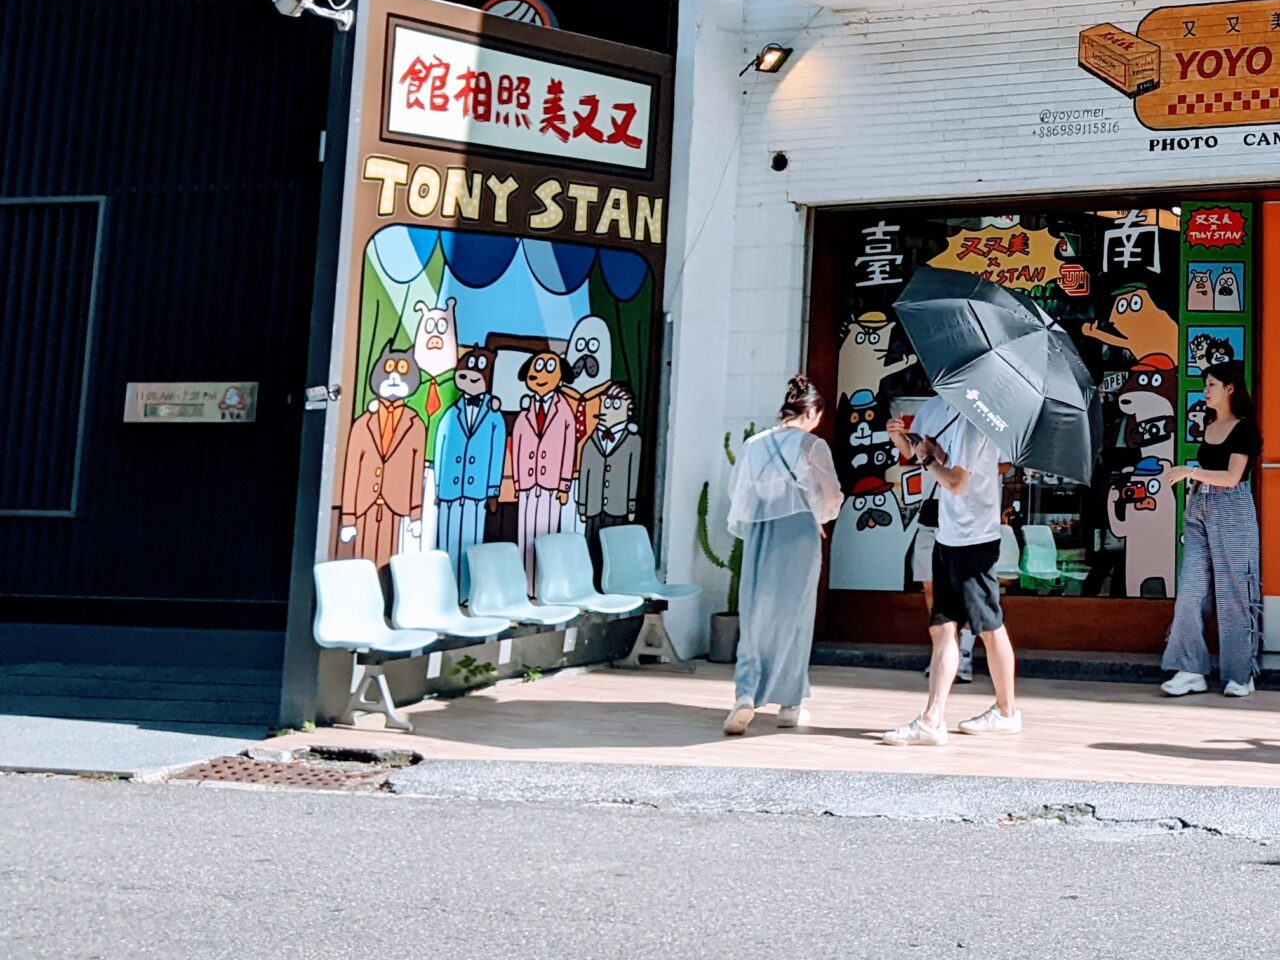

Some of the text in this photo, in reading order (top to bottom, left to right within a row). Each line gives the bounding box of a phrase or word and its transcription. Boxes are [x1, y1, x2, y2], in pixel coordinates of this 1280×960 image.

[1101, 32, 1135, 51] Kodak
[1175, 46, 1273, 81] YOYO
[1149, 135, 1218, 151] PHOTO
[362, 155, 663, 243] TONY STAN
[956, 232, 1031, 260] 又又美
[1189, 231, 1241, 239] TONY STAN
[854, 209, 1162, 287] 臺 南
[995, 264, 1046, 286] STAN
[1104, 373, 1127, 390] OPEN
